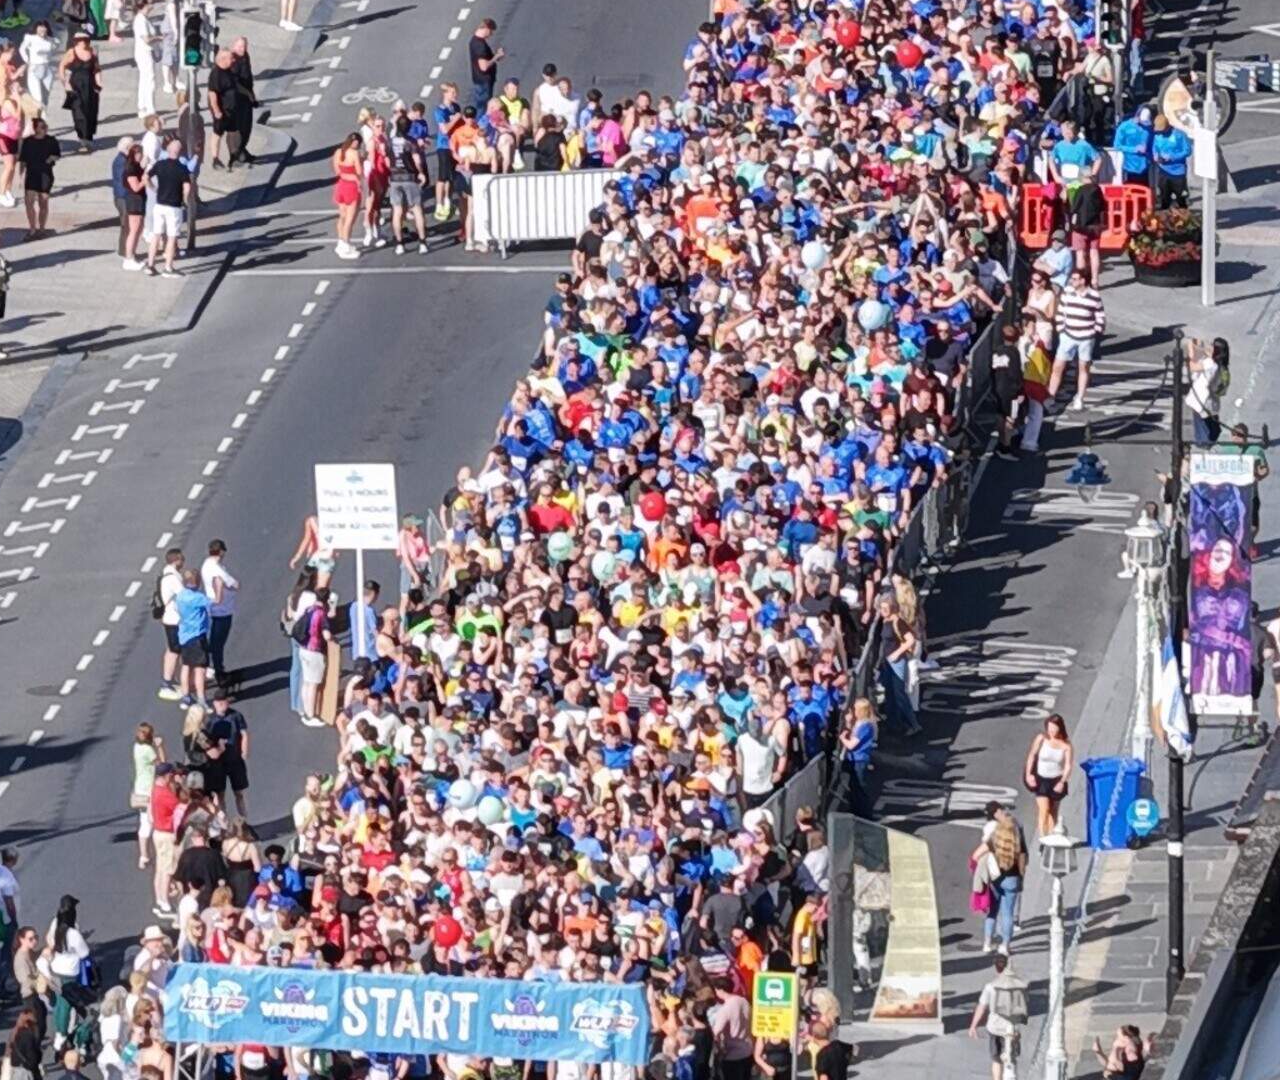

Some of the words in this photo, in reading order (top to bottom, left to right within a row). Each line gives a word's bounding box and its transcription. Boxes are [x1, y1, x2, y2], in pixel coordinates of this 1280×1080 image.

[260, 1001, 329, 1021] VIKING
[342, 986, 478, 1042] START
[491, 1013, 560, 1032] VIKING
[494, 1028, 559, 1040] MARATHON
